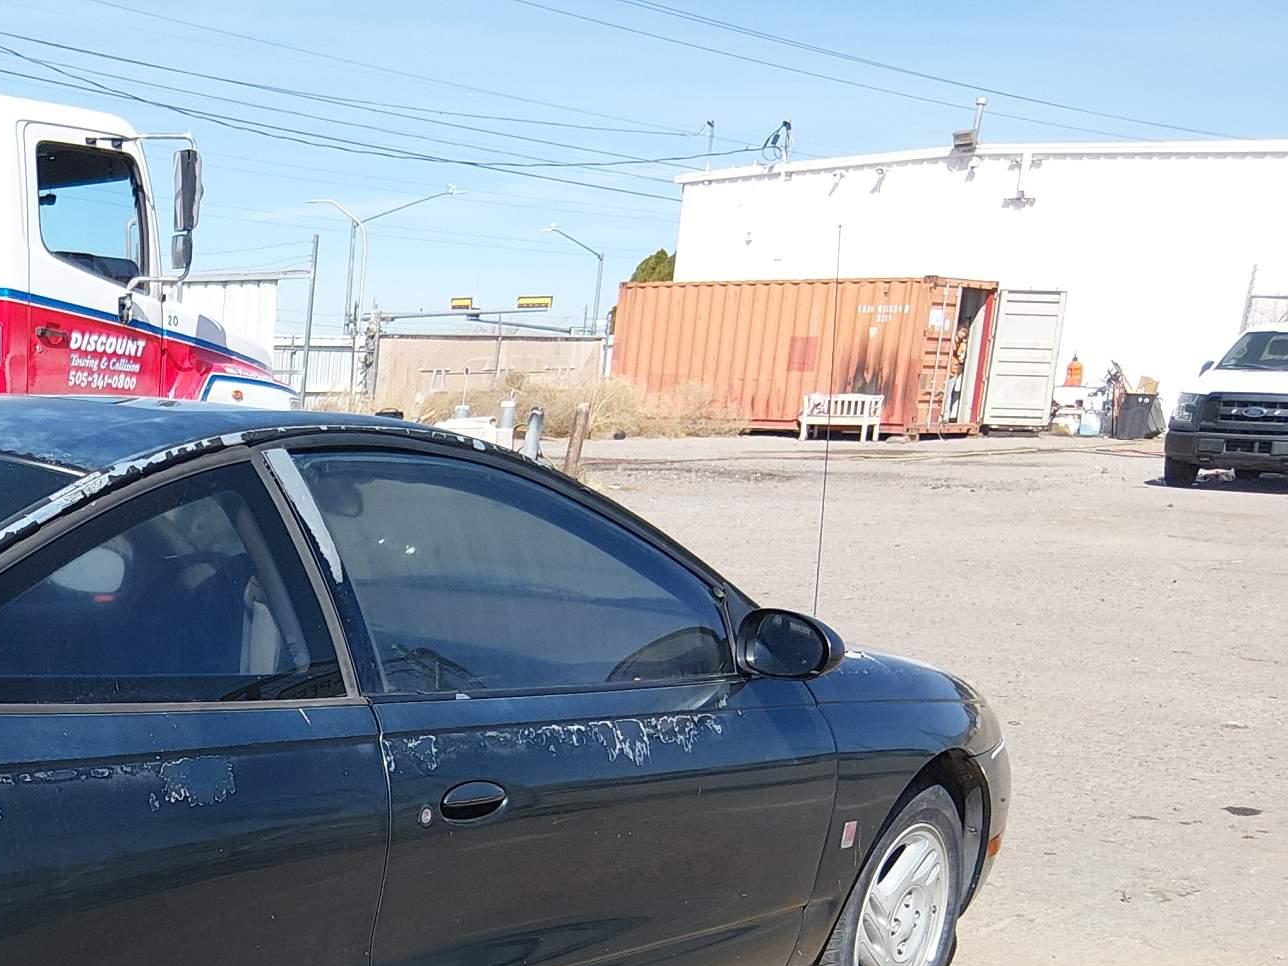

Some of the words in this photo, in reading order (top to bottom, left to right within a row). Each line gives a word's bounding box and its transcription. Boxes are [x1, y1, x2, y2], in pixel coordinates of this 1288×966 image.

[167, 314, 179, 327] 20
[69, 332, 146, 357] DISCOUNT
[71, 353, 99, 371] Towing
[100, 357, 108, 370] &
[109, 358, 140, 374] Collision
[68, 370, 137, 390] 505-341-0800
